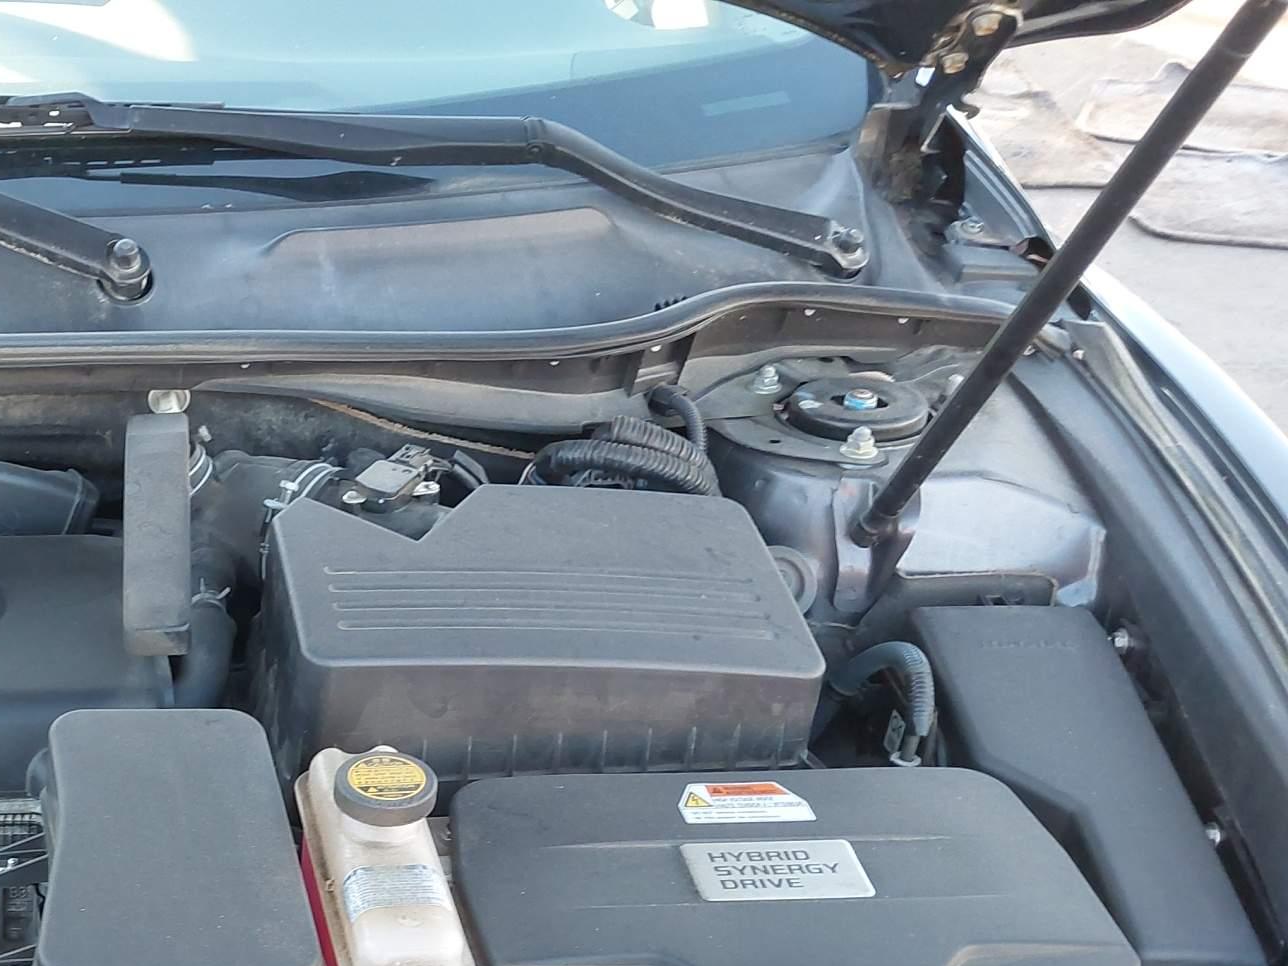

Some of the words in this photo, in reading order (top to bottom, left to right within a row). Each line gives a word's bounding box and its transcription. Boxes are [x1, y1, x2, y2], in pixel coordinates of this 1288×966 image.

[707, 850, 810, 863] HYBRID
[713, 863, 839, 877] SYNERGY
[720, 878, 804, 890] DRIVE
